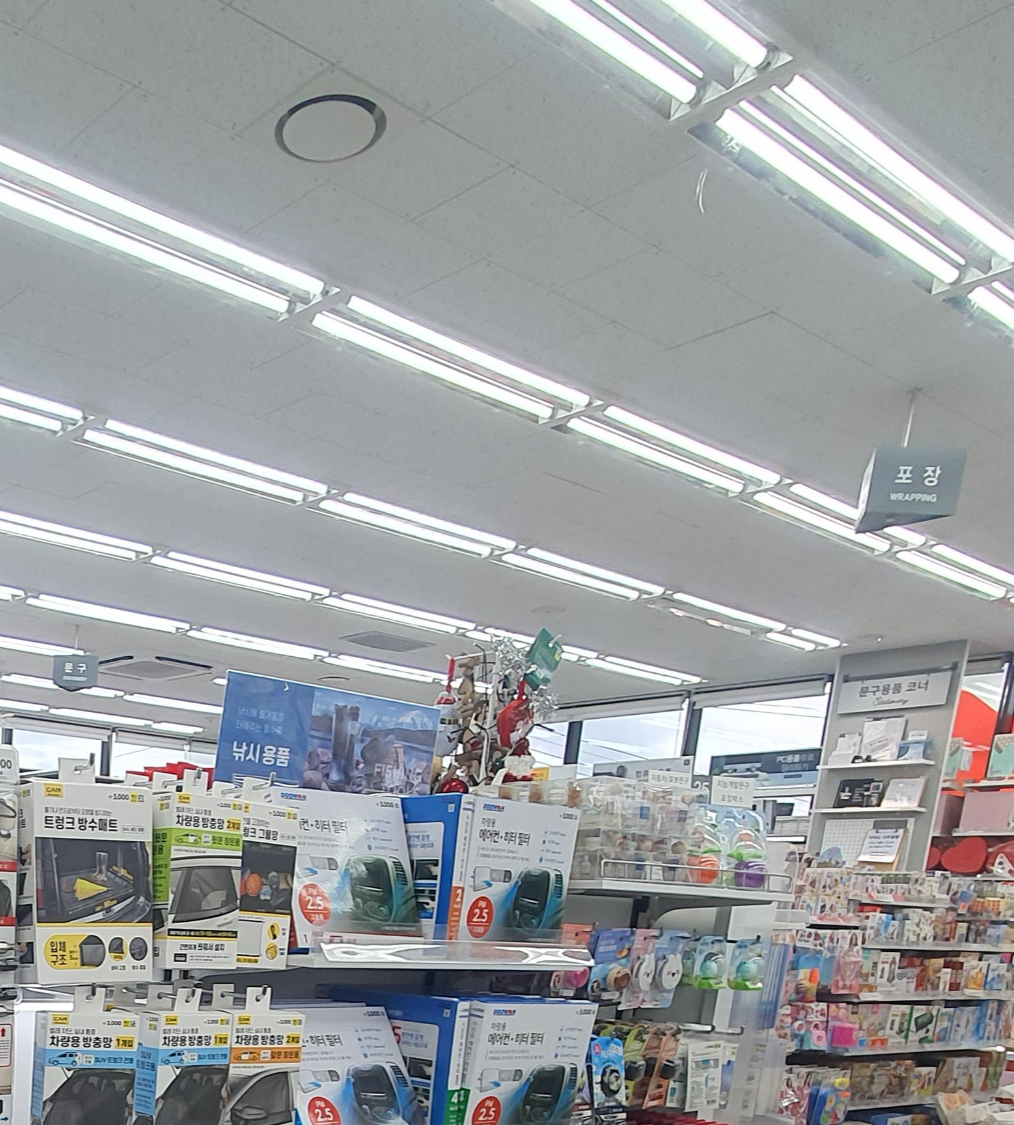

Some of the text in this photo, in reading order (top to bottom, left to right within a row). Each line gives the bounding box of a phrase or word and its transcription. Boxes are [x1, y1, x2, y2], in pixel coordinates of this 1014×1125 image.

[890, 493, 937, 502] WRAPPING
[859, 680, 929, 697] 문구용품 코너
[232, 741, 291, 768] 낚시 용품
[44, 815, 76, 830] 트렁크
[175, 814, 200, 828] 차량용
[201, 817, 225, 830] 방충망
[331, 820, 348, 833] 필터
[518, 833, 531, 846] 필터
[306, 897, 324, 910] 2.5
[472, 909, 489, 922] 2.5
[49, 940, 67, 953] 입체
[50, 954, 67, 966] 구조
[49, 1035, 134, 1049] 차량용 방충망 1개입
[162, 1035, 187, 1047] 차량용
[188, 1035, 212, 1047] 방충망
[235, 1034, 260, 1046] 차량용
[261, 1034, 284, 1046] 방충망
[530, 1033, 544, 1045] 필터
[314, 1108, 334, 1122] 2.5
[477, 1108, 496, 1121] 2.5
